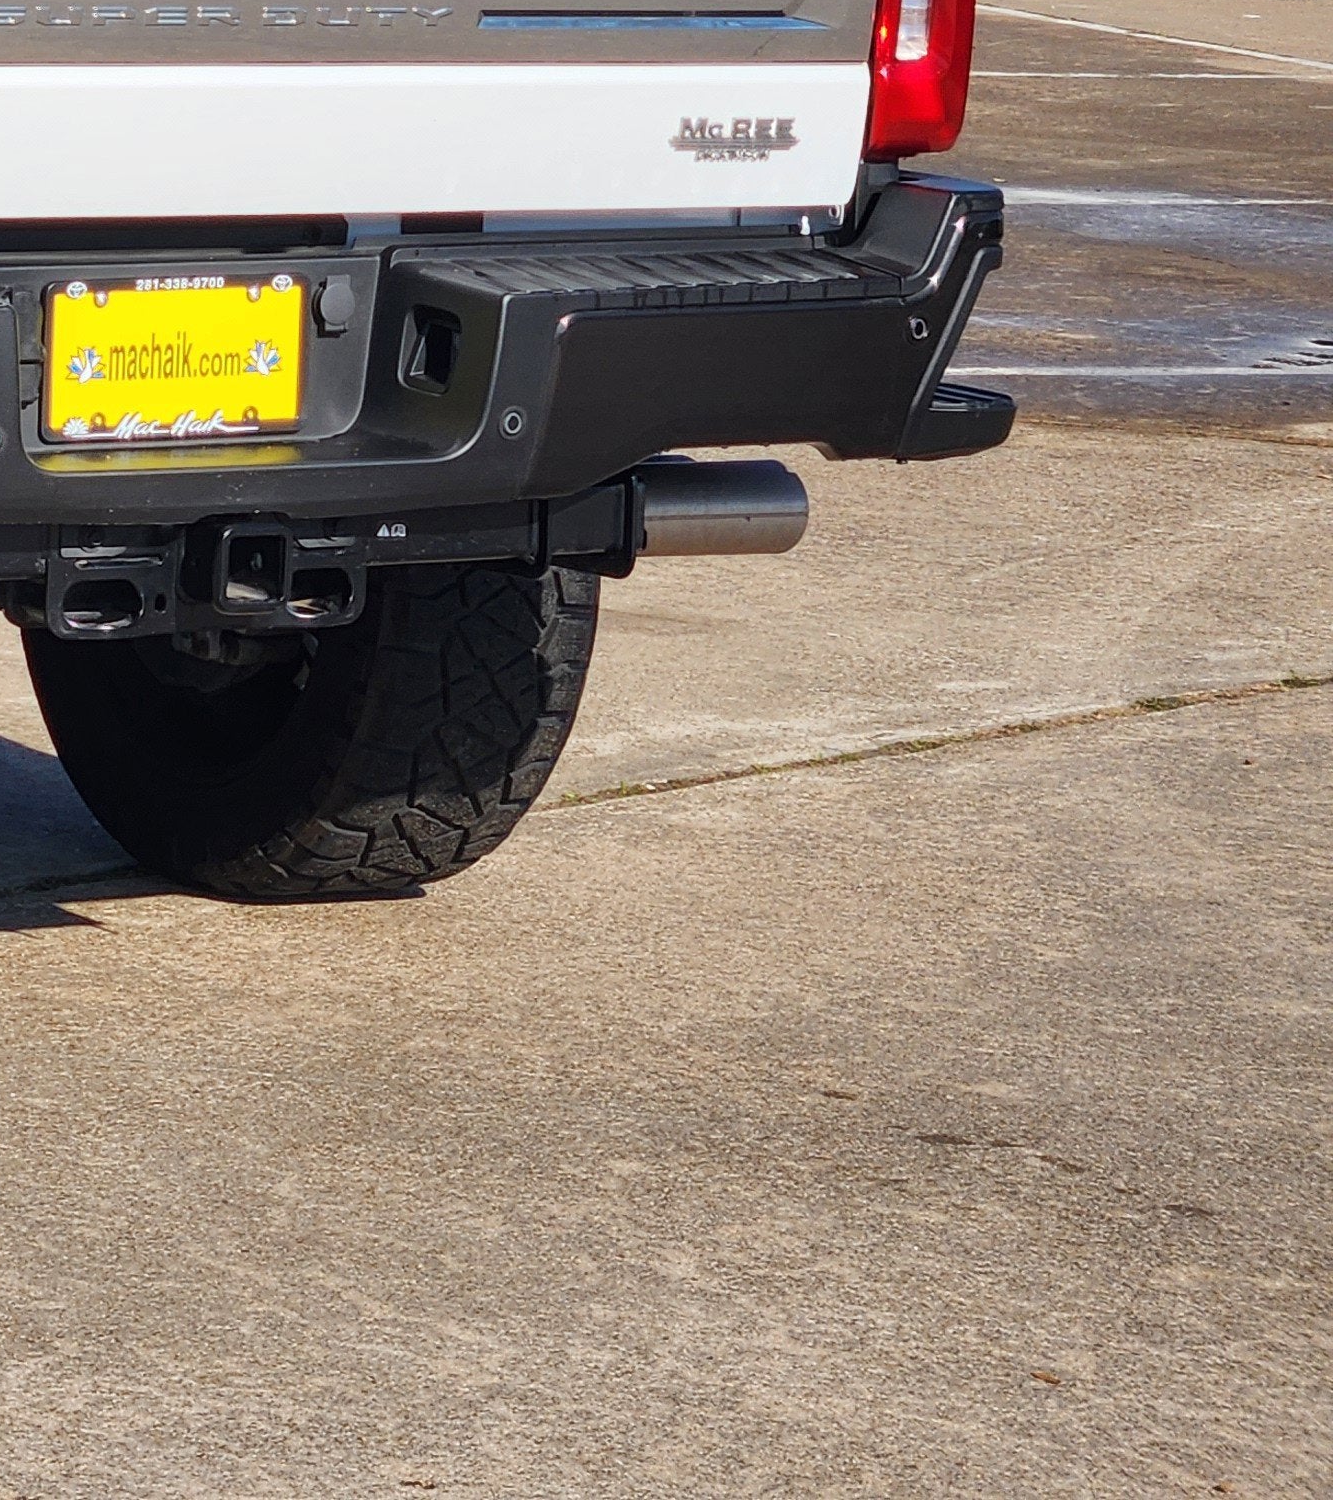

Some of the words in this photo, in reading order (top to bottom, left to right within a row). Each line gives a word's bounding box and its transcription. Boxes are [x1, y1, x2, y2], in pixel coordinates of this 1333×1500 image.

[261, 5, 454, 28] DUTY
[108, 330, 242, 381] machaik.com
[113, 411, 164, 440] Mac
[169, 409, 229, 438] Haik
